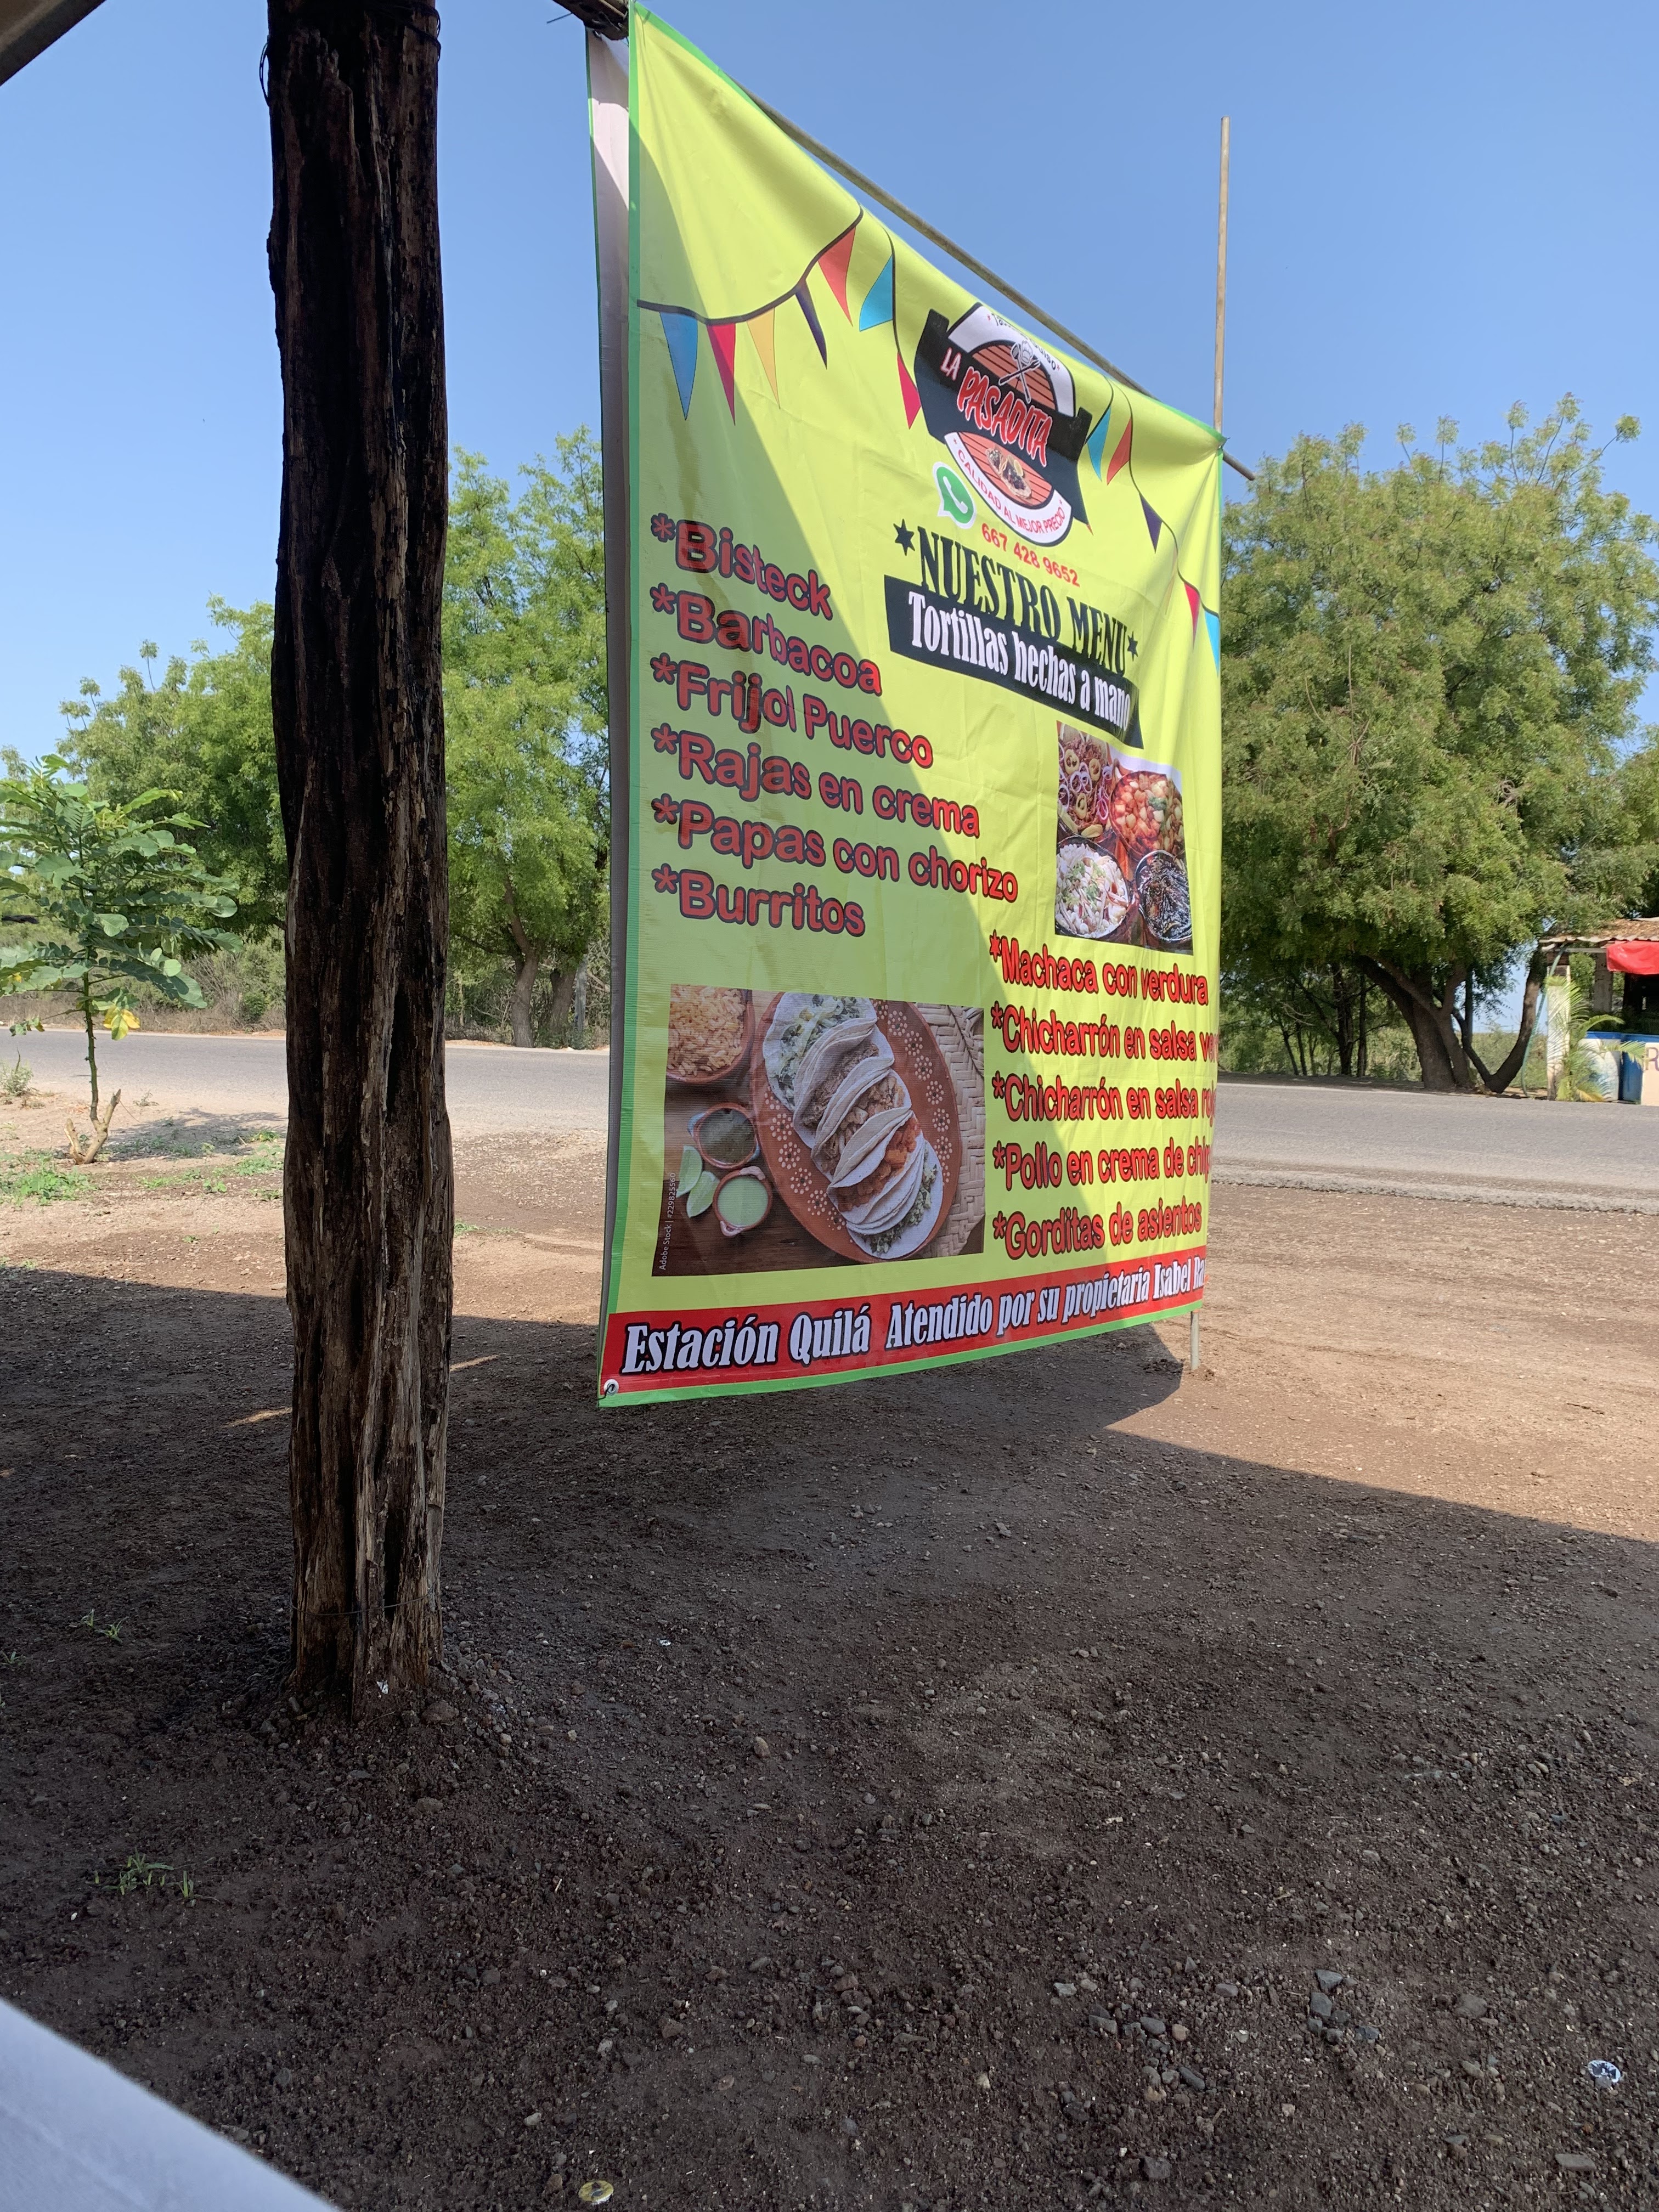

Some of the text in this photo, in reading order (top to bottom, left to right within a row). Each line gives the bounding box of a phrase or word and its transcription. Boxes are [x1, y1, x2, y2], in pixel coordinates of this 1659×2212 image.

[940, 347, 962, 381] LA
[1035, 345, 1057, 370] uiso
[957, 366, 1053, 467] PASADITA
[958, 449, 1065, 534] CALIDAD AL MEJOR PRECIO
[981, 523, 1080, 588] 667 428 9652
[917, 525, 1128, 678] NUESTRO MENU
[908, 590, 1131, 732] Tortillas hechas a mano
[803, 692, 933, 768] Puerco
[819, 772, 862, 814] en
[872, 785, 979, 838] crema
[833, 838, 899, 882] con
[908, 845, 1018, 902] chorizo
[1102, 962, 1138, 998] con
[1141, 964, 1209, 1006] verdura
[1124, 1028, 1144, 1059] en
[1149, 1020, 1197, 1061] salsa
[1126, 1087, 1151, 1119] en
[1155, 1078, 1198, 1119] salsa
[1067, 1150, 1093, 1186] en
[1098, 1146, 1159, 1183] crema
[1164, 1137, 1184, 1178] de
[667, 1172, 676, 1218] #229825560
[1109, 1201, 1133, 1246] de
[1137, 1195, 1202, 1242] asientos
[659, 1246, 669, 1270] Adobe
[663, 1224, 672, 1245] Stock
[620, 1313, 781, 1375] Estación
[788, 1303, 872, 1367] Quilá
[884, 1293, 992, 1351] Atendido
[997, 1290, 1035, 1338] por
[1037, 1284, 1059, 1325] su
[1063, 1265, 1151, 1324] propietaria
[1152, 1256, 1193, 1301] Isabel
